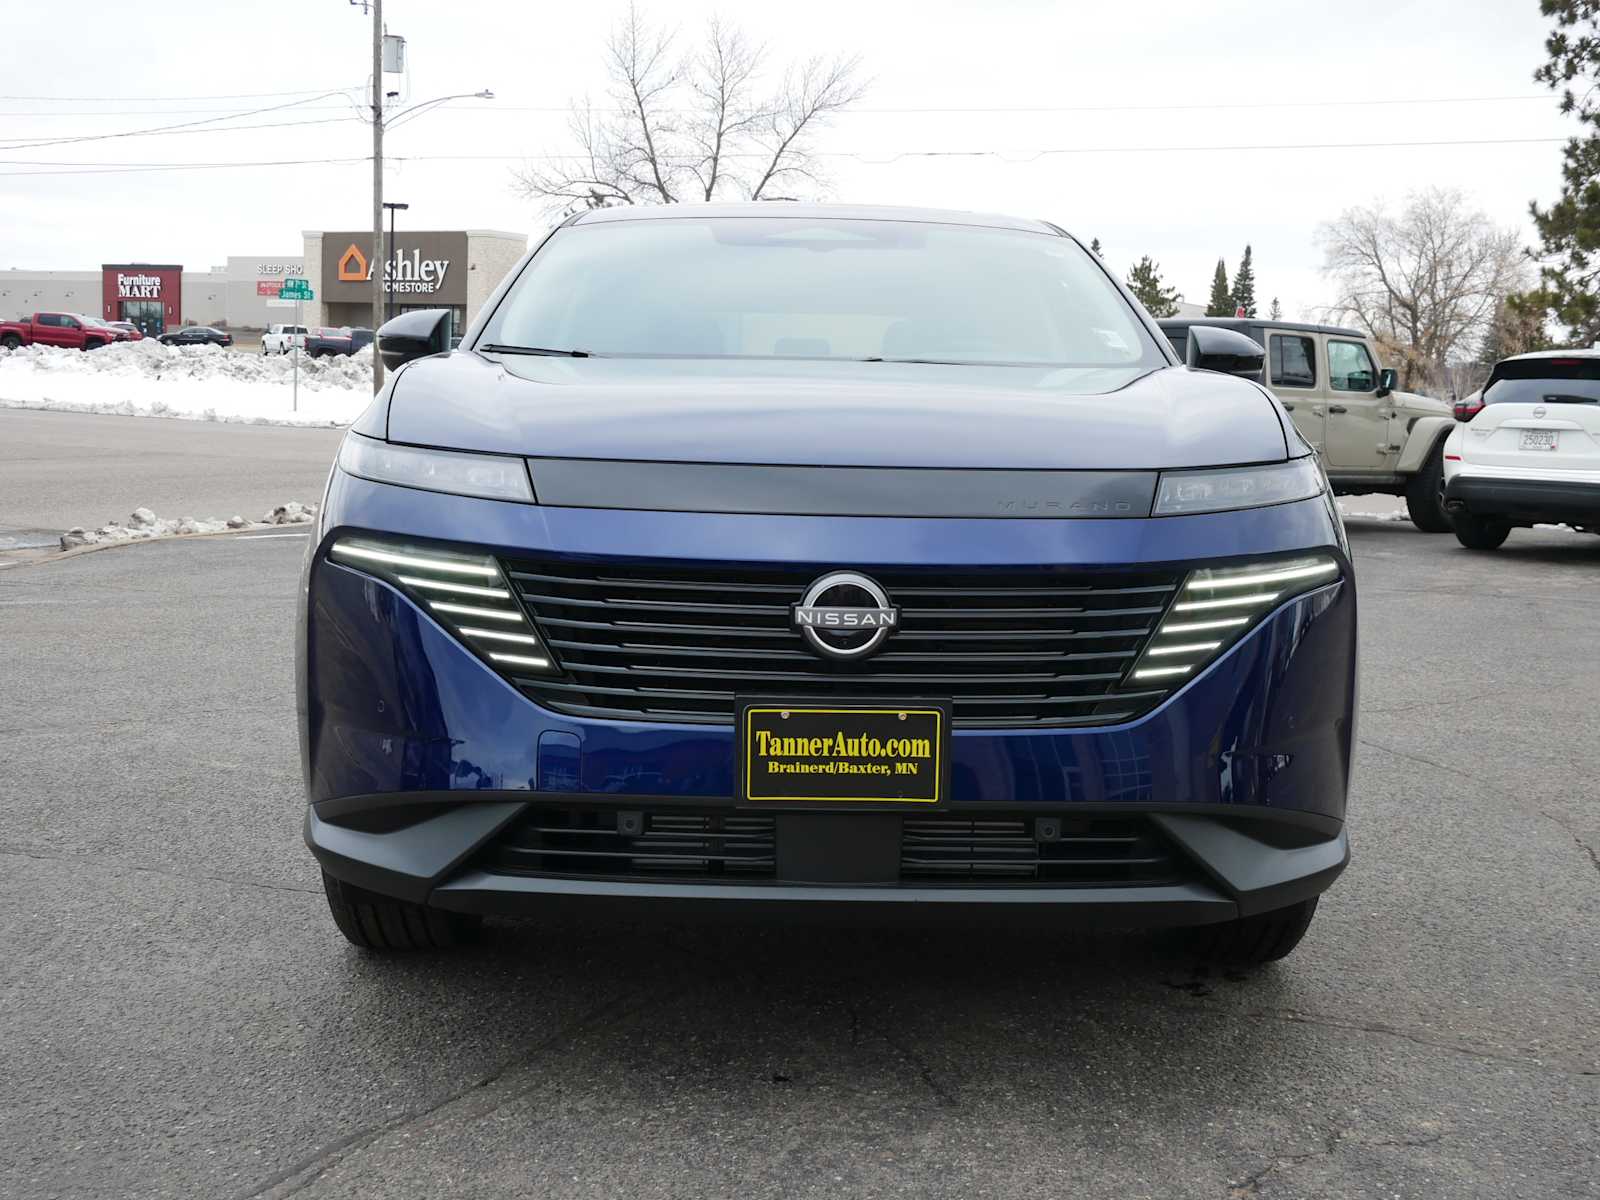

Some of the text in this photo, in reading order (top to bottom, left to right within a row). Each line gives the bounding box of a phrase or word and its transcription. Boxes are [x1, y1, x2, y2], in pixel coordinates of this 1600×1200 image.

[257, 264, 283, 274] SLEEP
[117, 273, 161, 287] Furniture
[118, 285, 161, 298] MART
[382, 282, 434, 293] OMESTORE
[997, 500, 1131, 511] MURANO
[797, 611, 894, 626] NISSAN
[755, 731, 931, 758] TannerAuto.com
[767, 762, 919, 776] Brainerd/Baxter, MN
